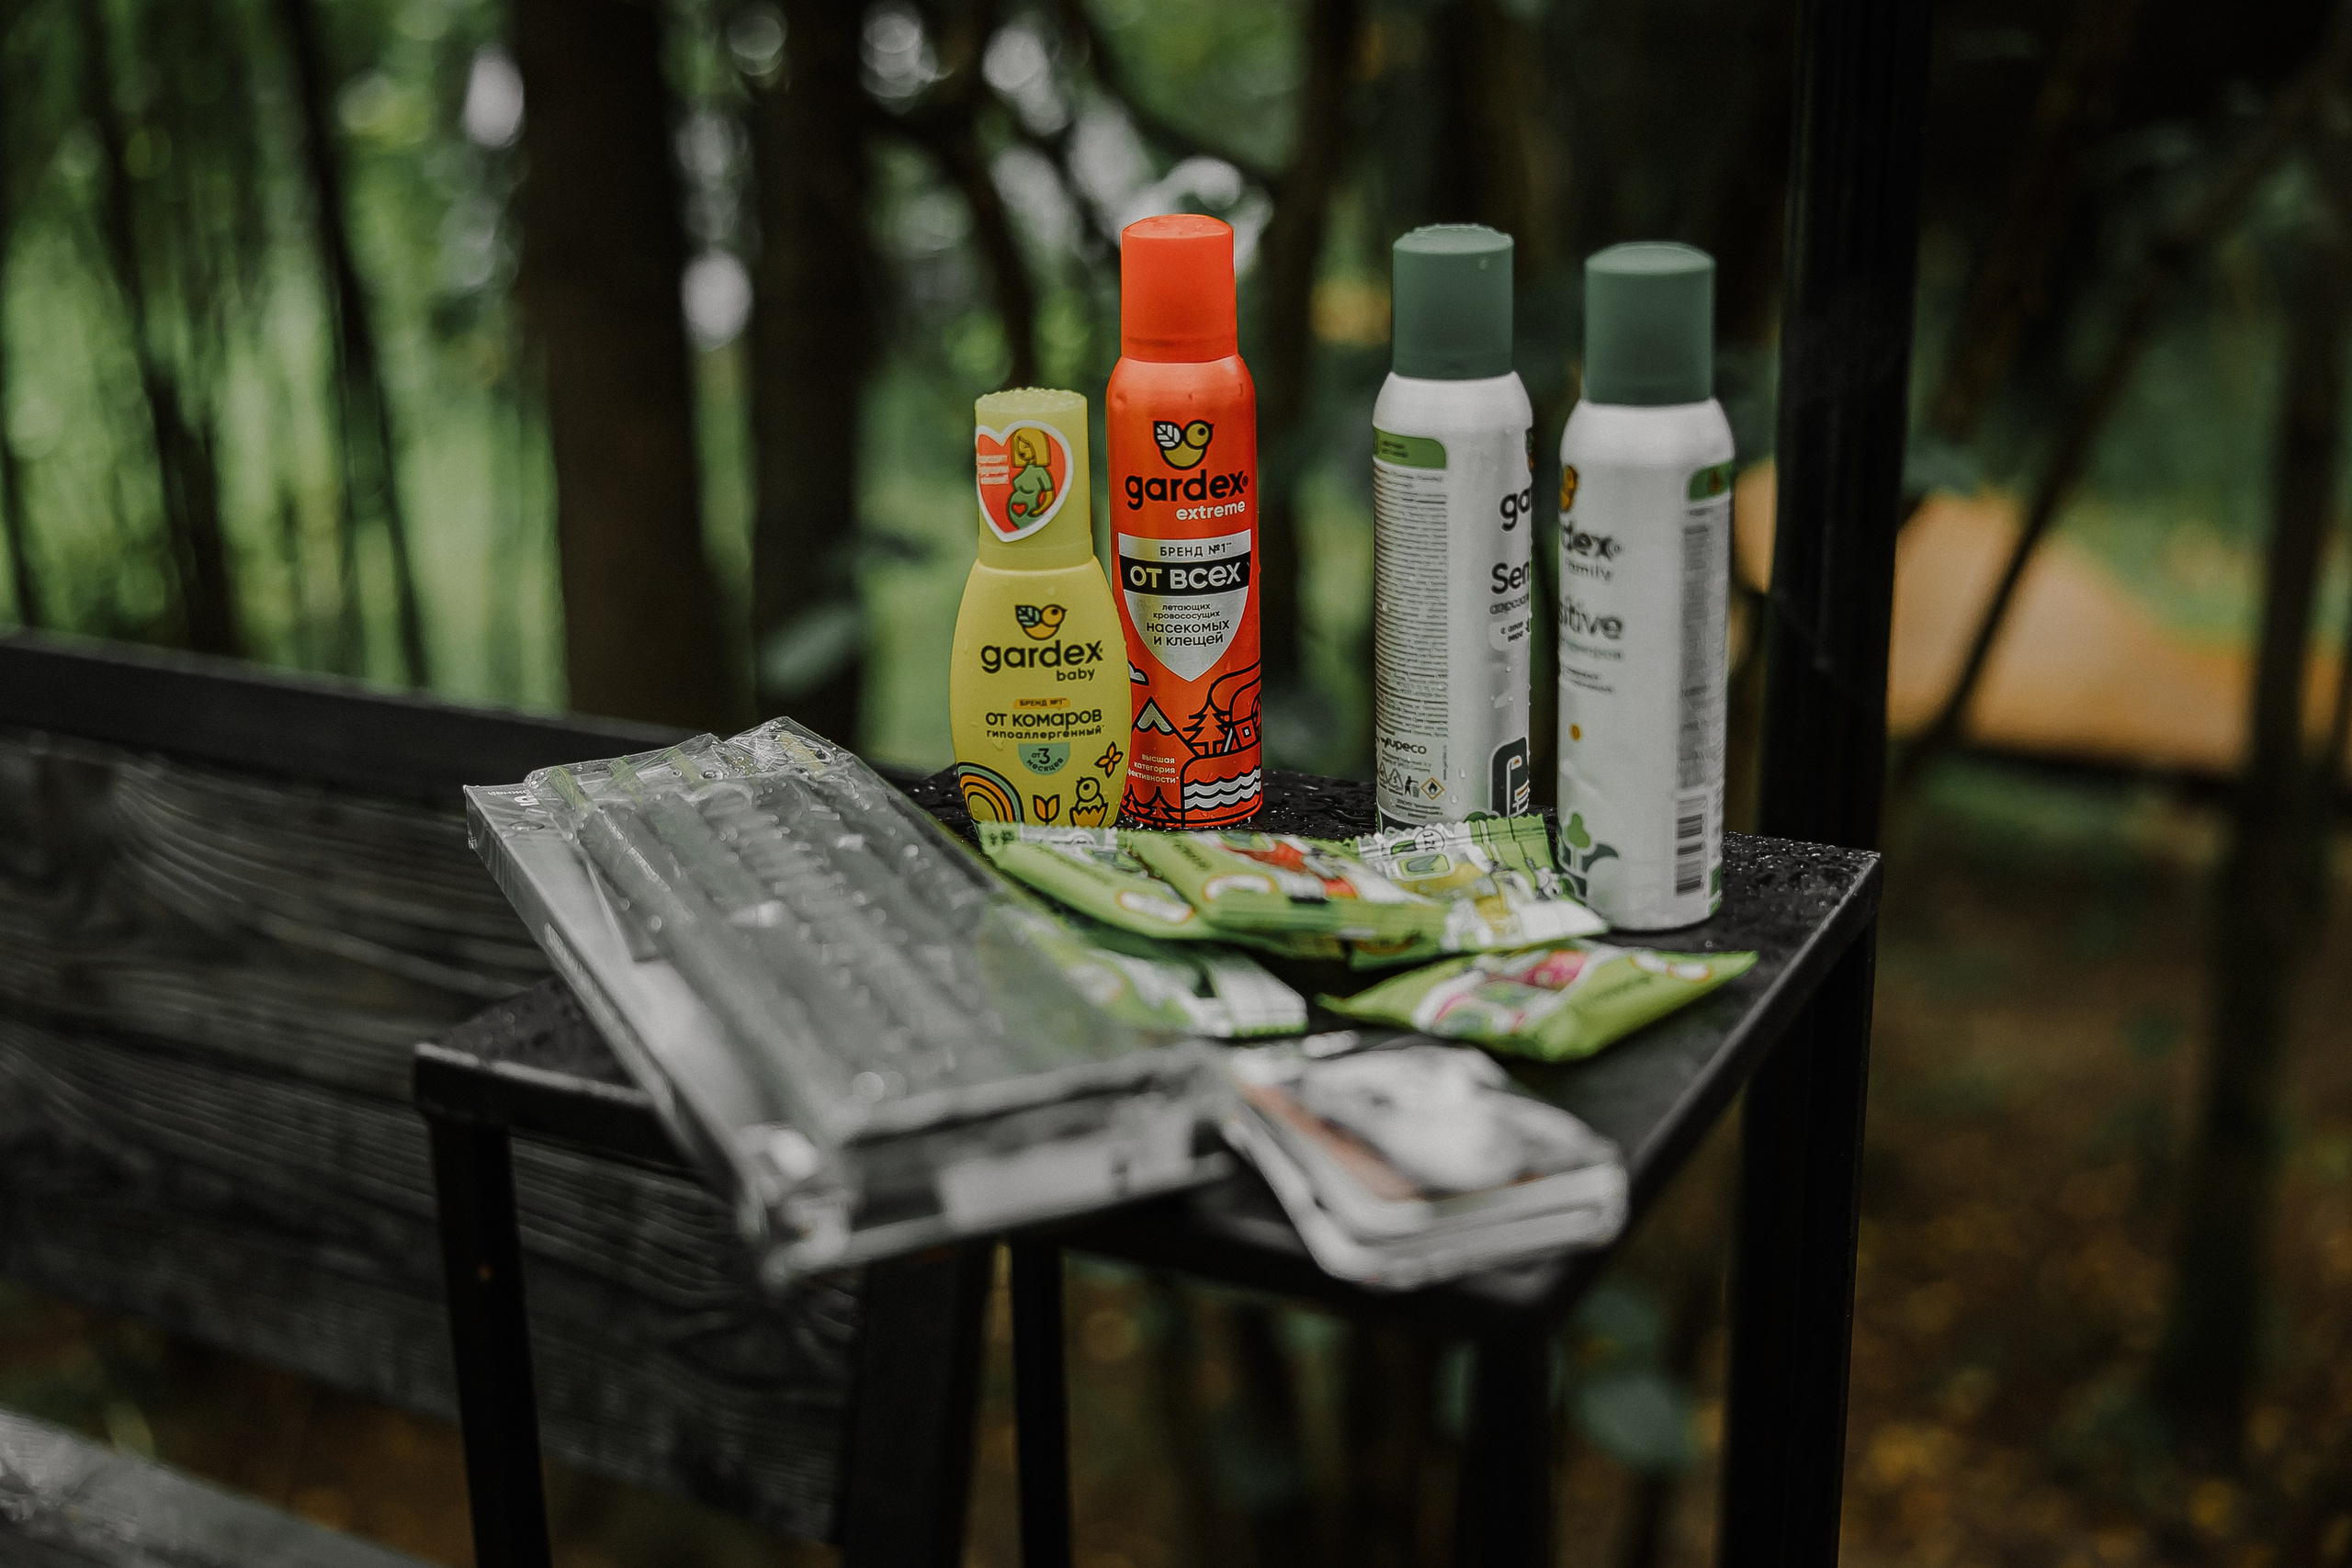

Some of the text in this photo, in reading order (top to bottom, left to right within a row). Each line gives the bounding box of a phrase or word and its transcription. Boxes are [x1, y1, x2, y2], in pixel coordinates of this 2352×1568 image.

[1125, 468, 1249, 511] gardex
[1176, 501, 1246, 521] extreme
[1499, 486, 1530, 532] ga
[1159, 546, 1204, 558] БРЕНД
[1490, 561, 1530, 594] Sen
[1152, 611, 1221, 621] кровососущих
[1161, 604, 1211, 612] летающих
[1146, 620, 1230, 634] насекомых
[1153, 631, 1224, 648] и клещей
[980, 639, 1103, 674] gardex
[1057, 668, 1096, 682] baby
[1012, 709, 1102, 731] комаров
[986, 726, 1103, 740] гипоаллергенный
[1038, 748, 1051, 765] 3
[1141, 754, 1175, 764] высшая
[1025, 757, 1064, 773] месяцев
[1134, 761, 1176, 774] категория
[1127, 767, 1177, 784] фективности
